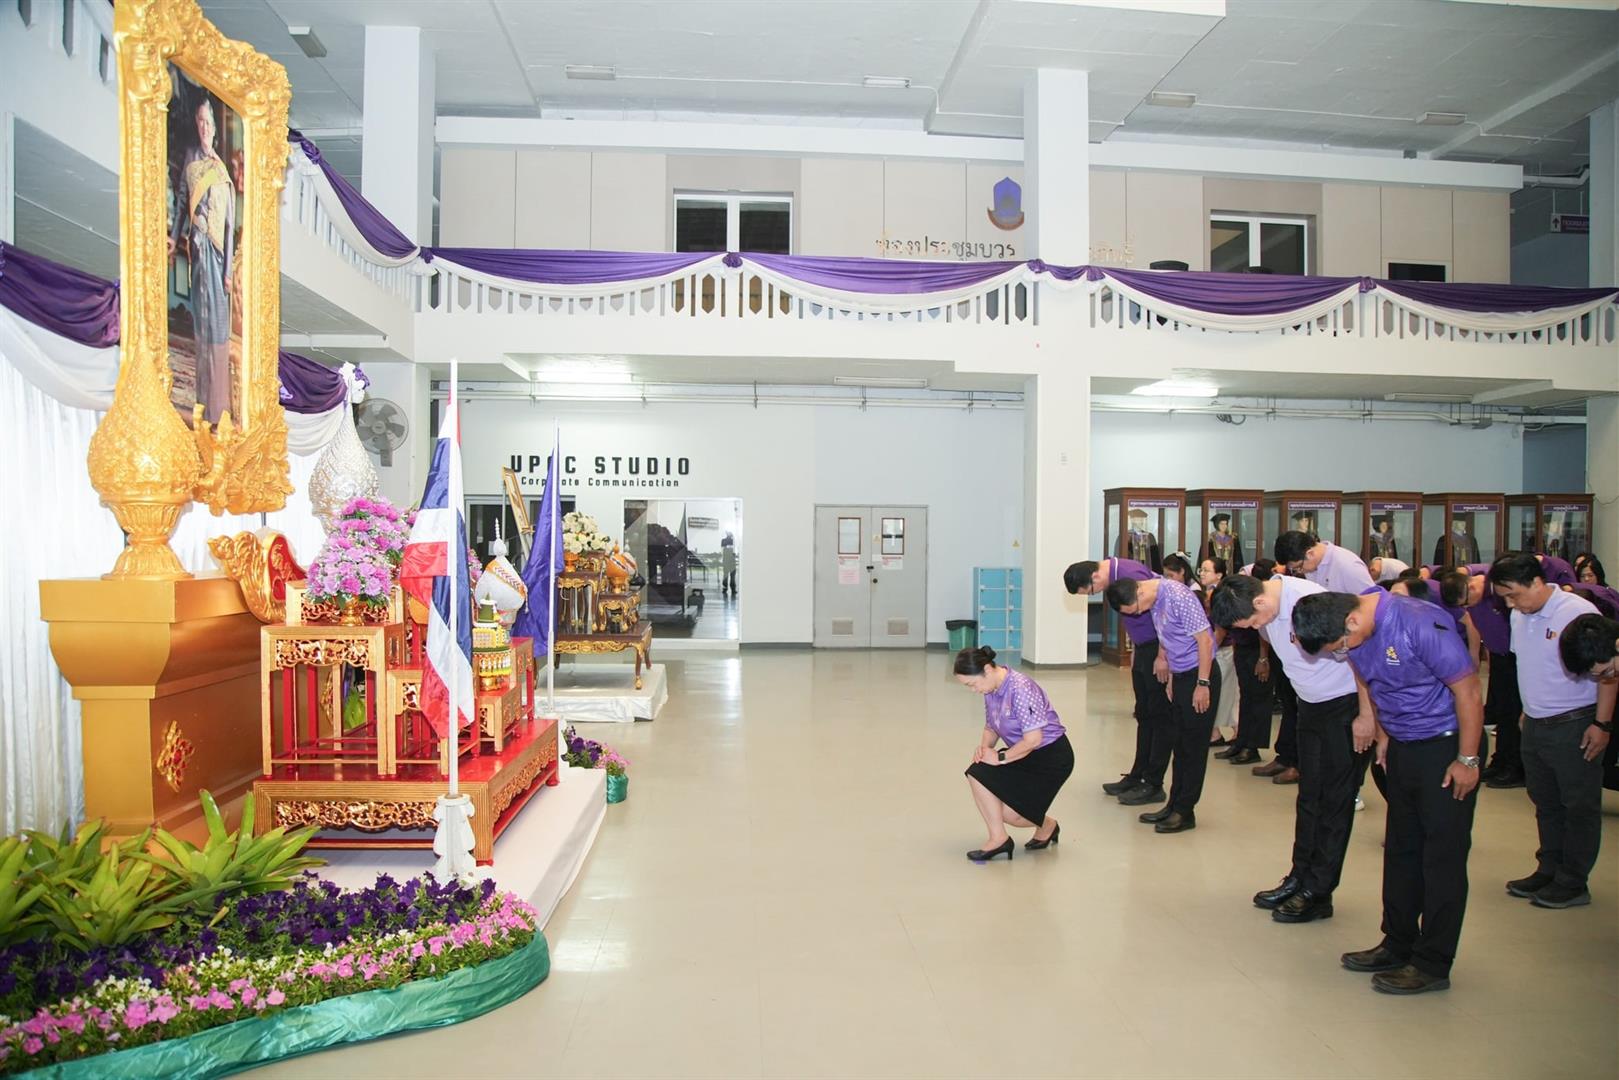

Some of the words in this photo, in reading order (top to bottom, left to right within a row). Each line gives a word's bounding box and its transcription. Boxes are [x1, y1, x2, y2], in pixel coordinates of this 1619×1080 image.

[594, 456, 690, 476] STUDIO
[522, 476, 579, 487] Corpate
[588, 477, 679, 487] Communication
